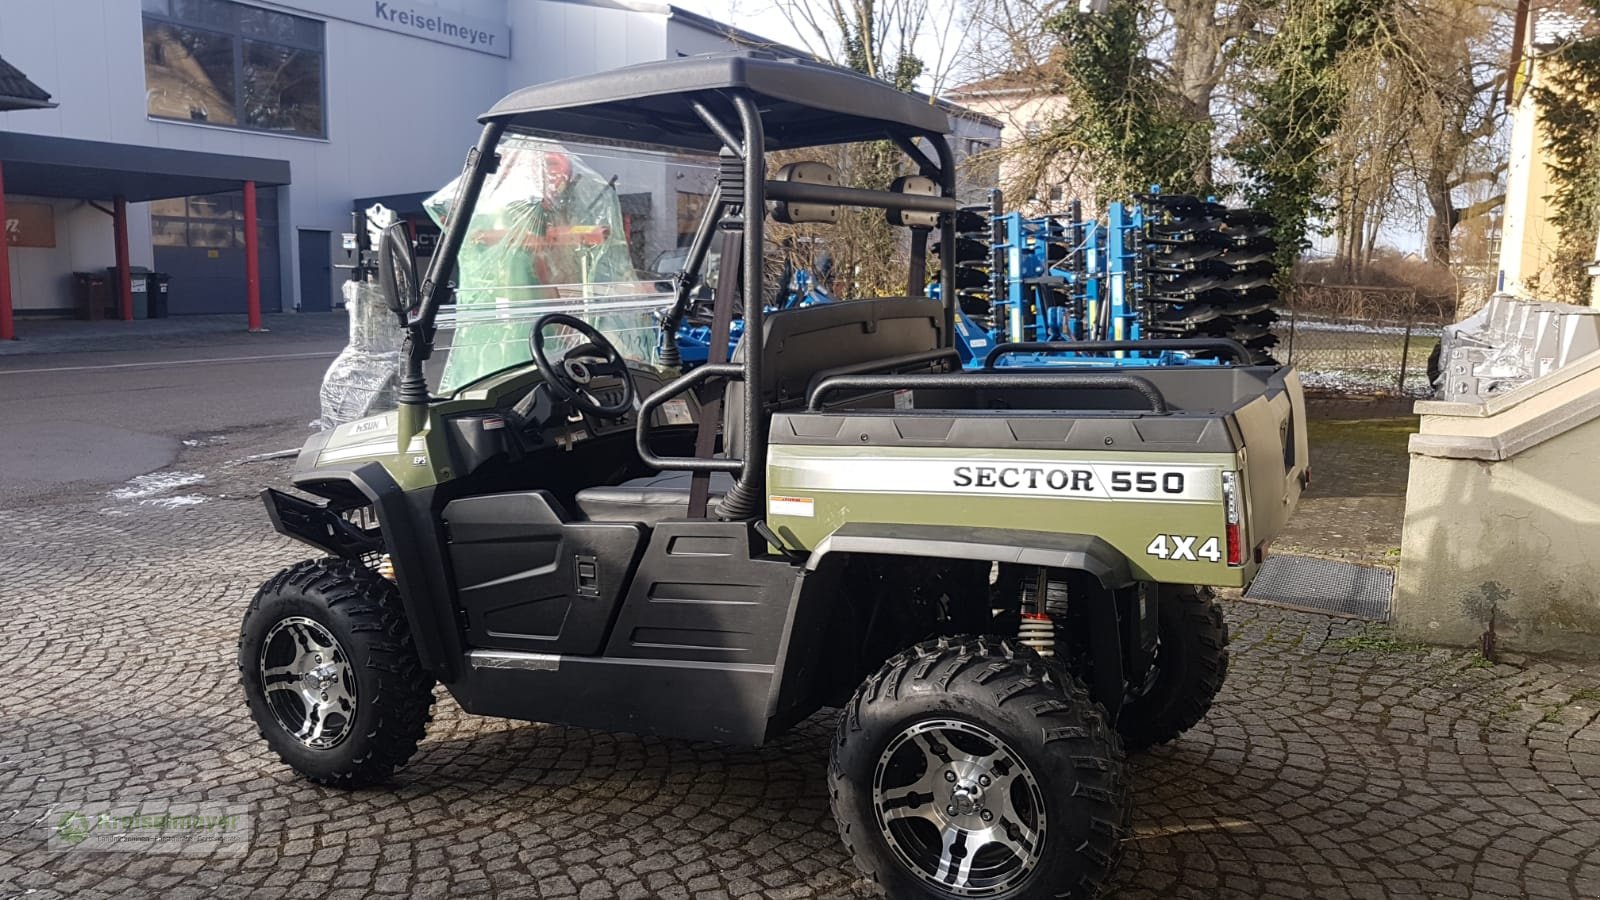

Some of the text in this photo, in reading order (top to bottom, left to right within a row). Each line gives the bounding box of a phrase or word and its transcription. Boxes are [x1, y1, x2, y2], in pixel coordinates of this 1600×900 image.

[375, 1, 496, 45] Kreiselmeyer
[953, 466, 1185, 494] SECTOR 550
[1145, 533, 1222, 563] 4X4
